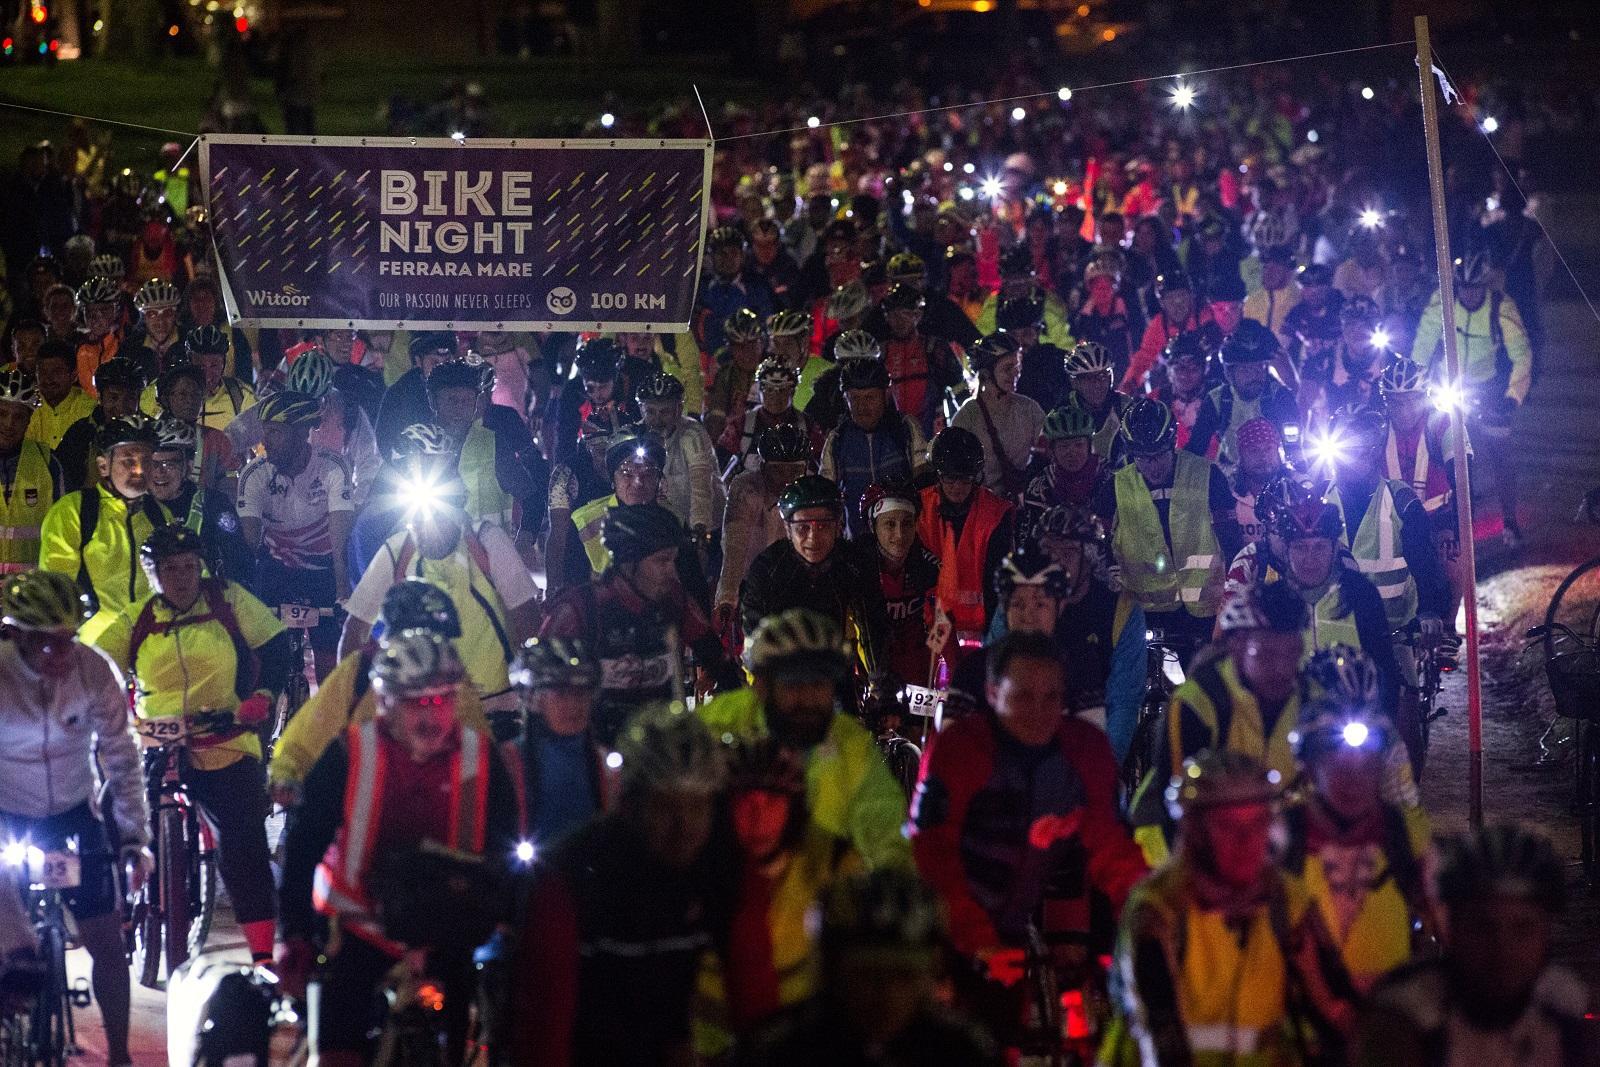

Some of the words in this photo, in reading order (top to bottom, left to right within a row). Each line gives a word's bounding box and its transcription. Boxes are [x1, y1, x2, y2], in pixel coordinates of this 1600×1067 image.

[380, 169, 533, 217] BIKE
[379, 221, 533, 255] NIGHT
[379, 261, 473, 277] FERRARA
[477, 262, 533, 277] MARE
[245, 289, 311, 307] Witoor
[379, 292, 400, 308] OUR
[405, 292, 449, 308] PASSION
[454, 293, 489, 309] NEVER
[494, 293, 532, 309] SLEEPS
[591, 292, 628, 309] 100
[634, 293, 666, 310] KM
[291, 607, 310, 619] 97
[914, 693, 934, 707] 92
[144, 722, 180, 736] 329
